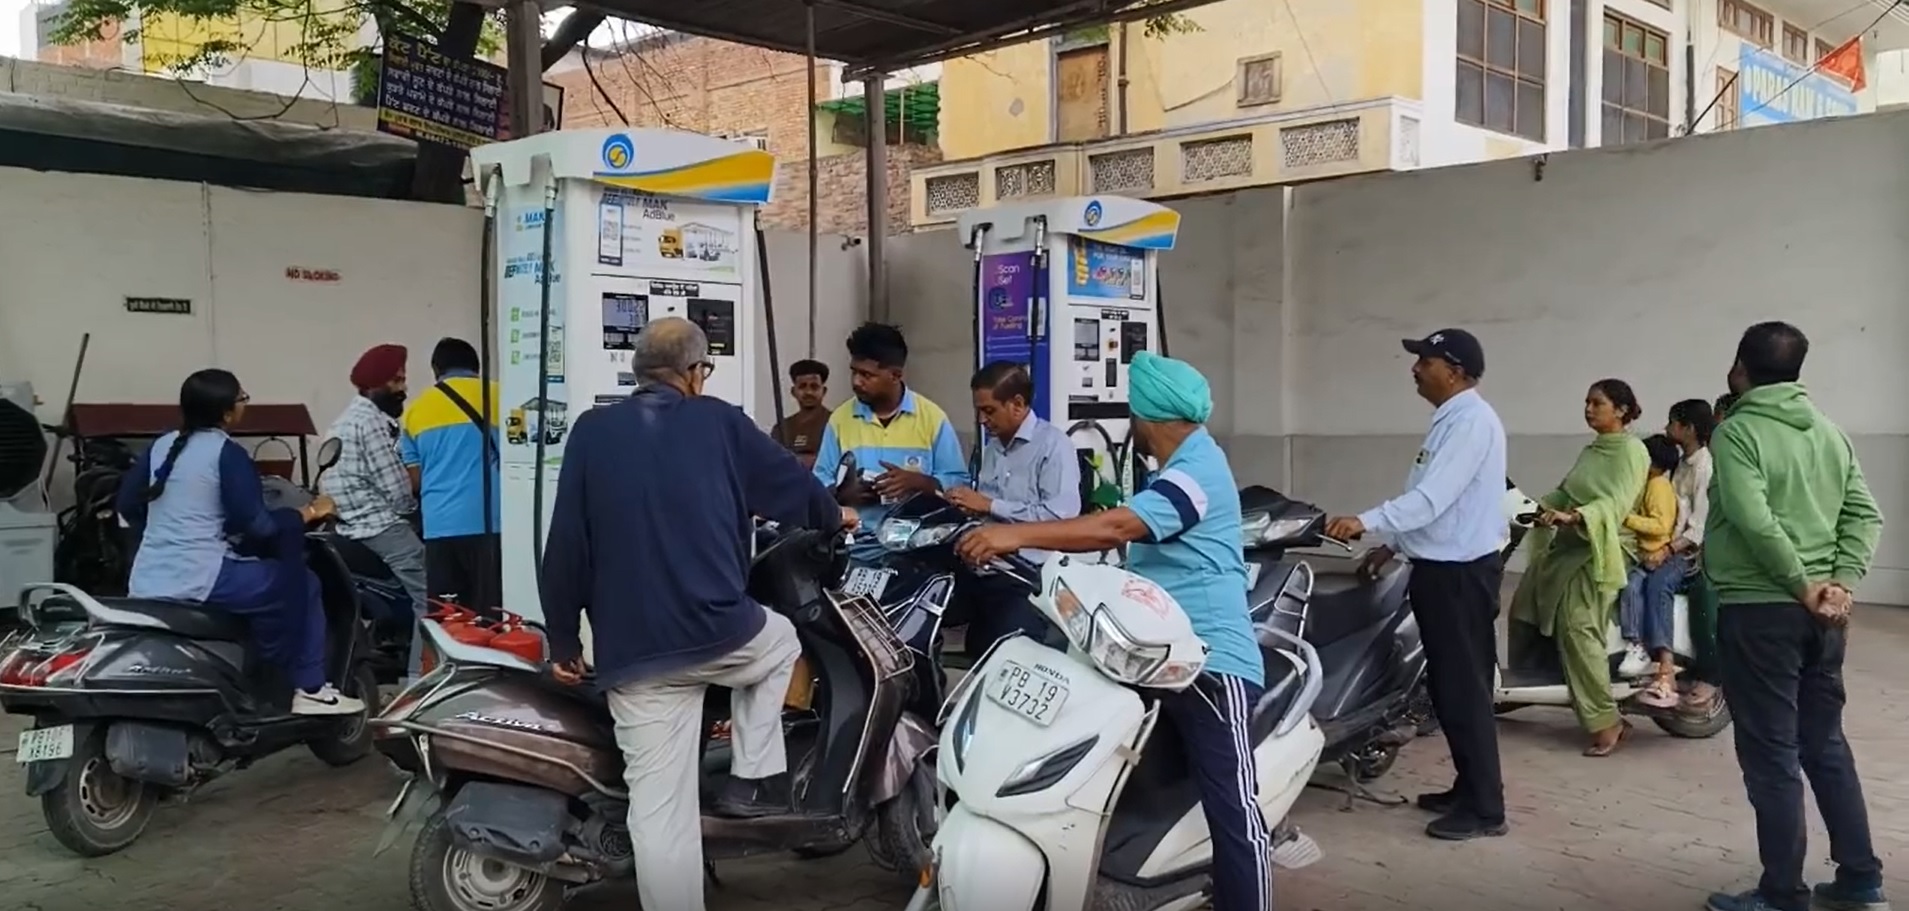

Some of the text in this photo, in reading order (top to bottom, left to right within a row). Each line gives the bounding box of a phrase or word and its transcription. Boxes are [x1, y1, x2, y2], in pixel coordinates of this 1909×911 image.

[642, 197, 669, 210] MAK
[642, 208, 676, 222] AdBlue
[997, 263, 1020, 274] Scan
[1009, 666, 1031, 688] PB
[1039, 681, 1059, 702] 19
[1034, 663, 1070, 685] HONDA
[1000, 685, 1049, 721] V3732
[455, 710, 545, 731] Activa
